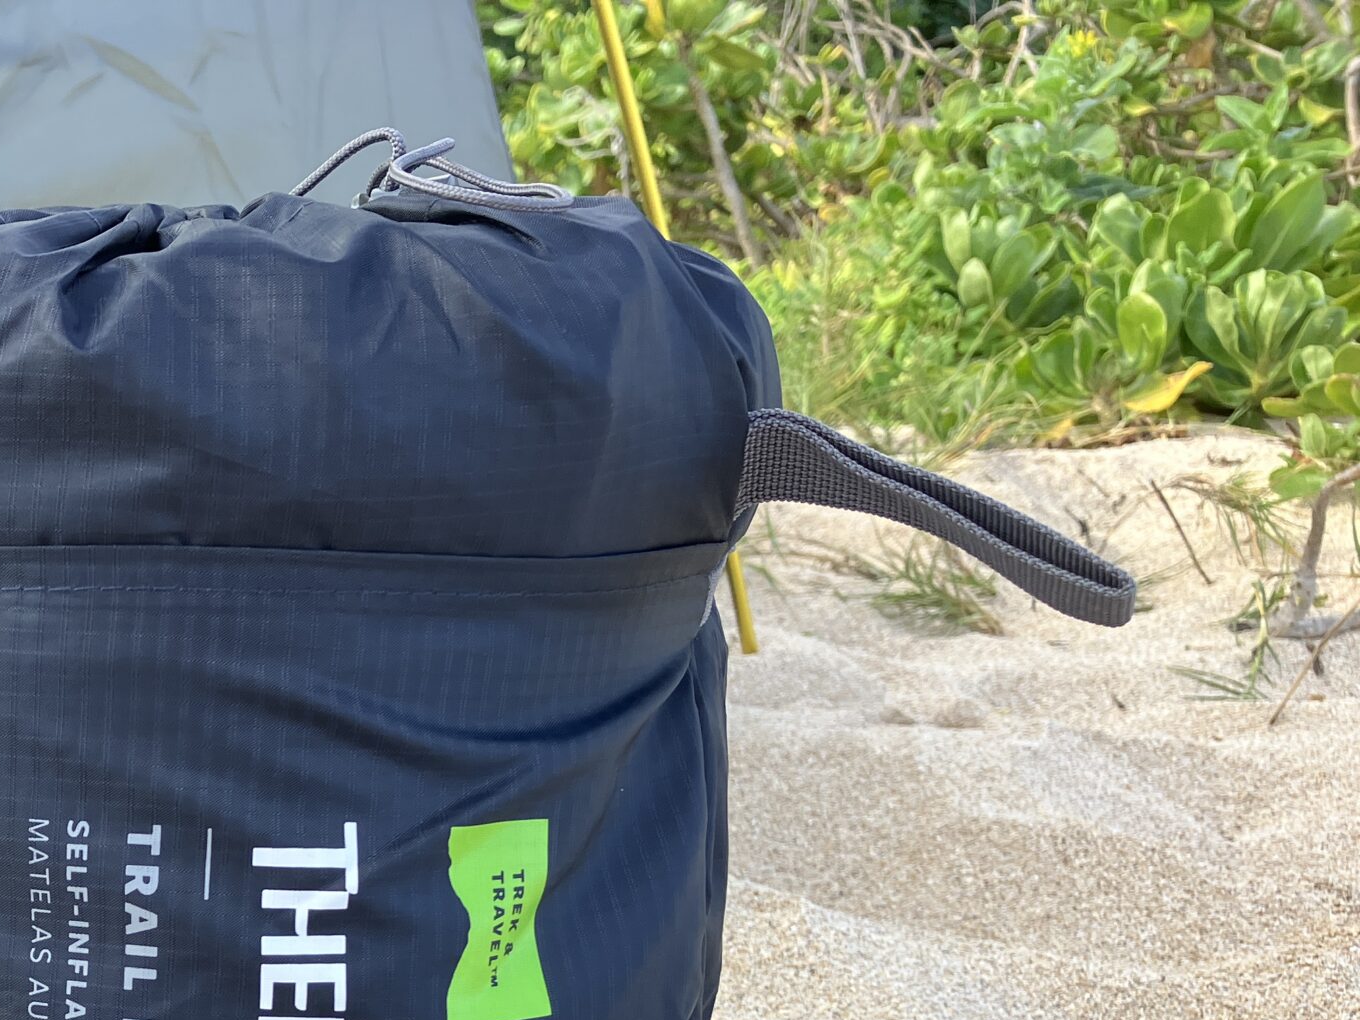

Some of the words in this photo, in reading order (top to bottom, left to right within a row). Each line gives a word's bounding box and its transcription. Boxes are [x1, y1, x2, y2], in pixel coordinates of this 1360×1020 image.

[27, 818, 53, 964] MATELAS
[123, 824, 162, 991] TRAIL
[508, 868, 525, 932] TREK
[503, 942, 515, 957] &
